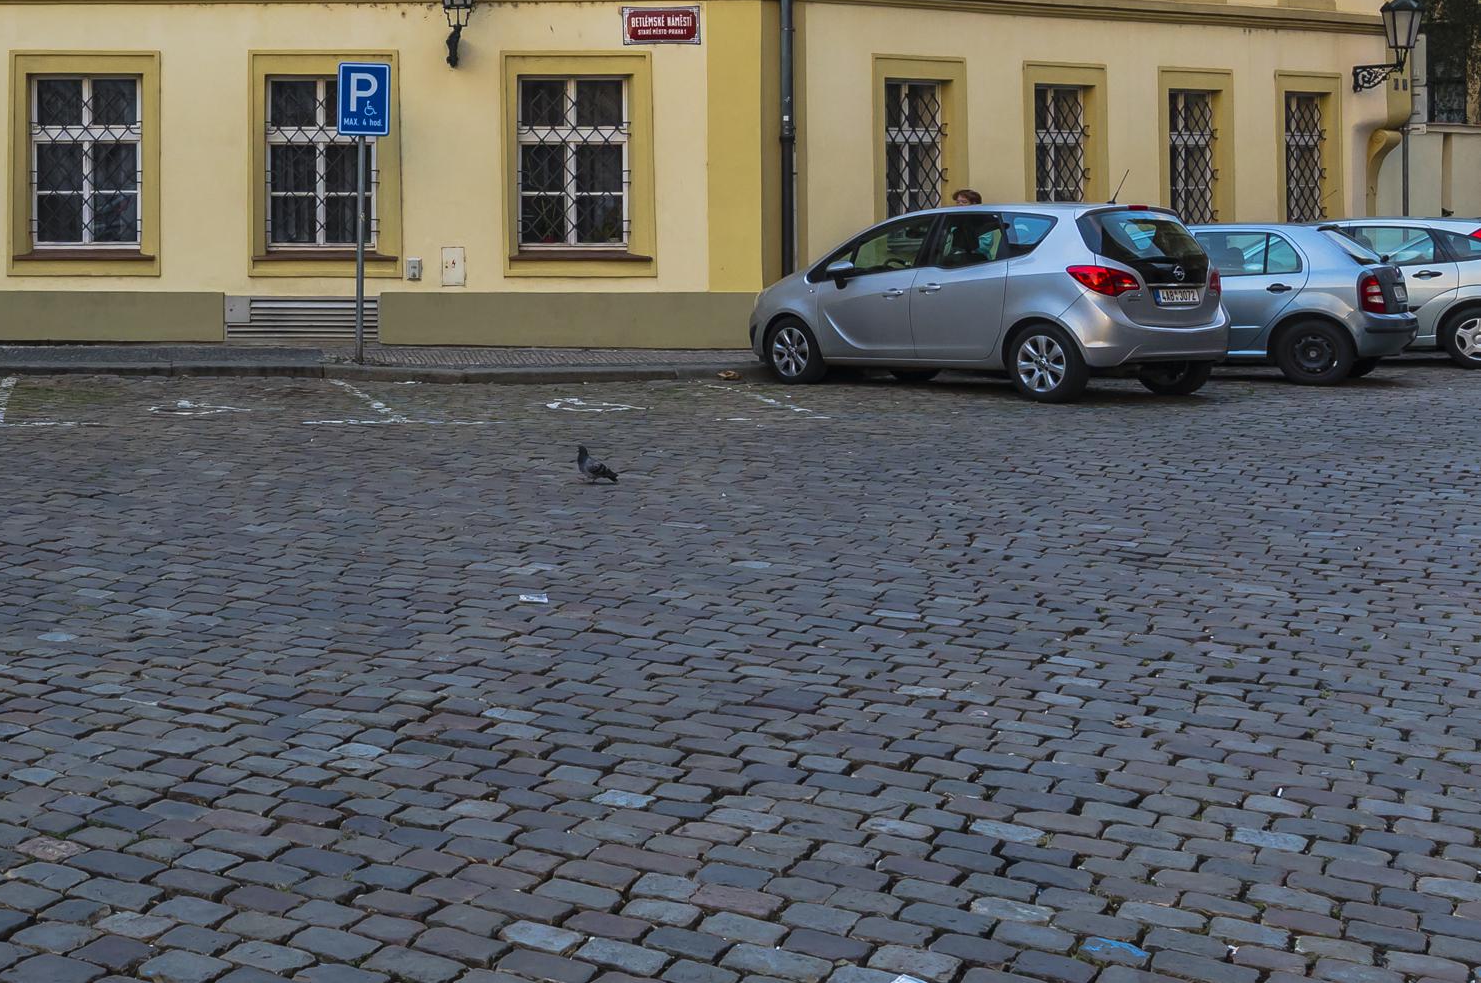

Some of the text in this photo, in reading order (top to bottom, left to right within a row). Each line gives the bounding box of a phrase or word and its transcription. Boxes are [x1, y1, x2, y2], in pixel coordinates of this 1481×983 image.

[631, 14, 693, 27] BETLÉMSKÉ NÁMĚSTÍ
[350, 72, 378, 112] P
[343, 117, 360, 126] MAX.
[362, 118, 367, 126] 4
